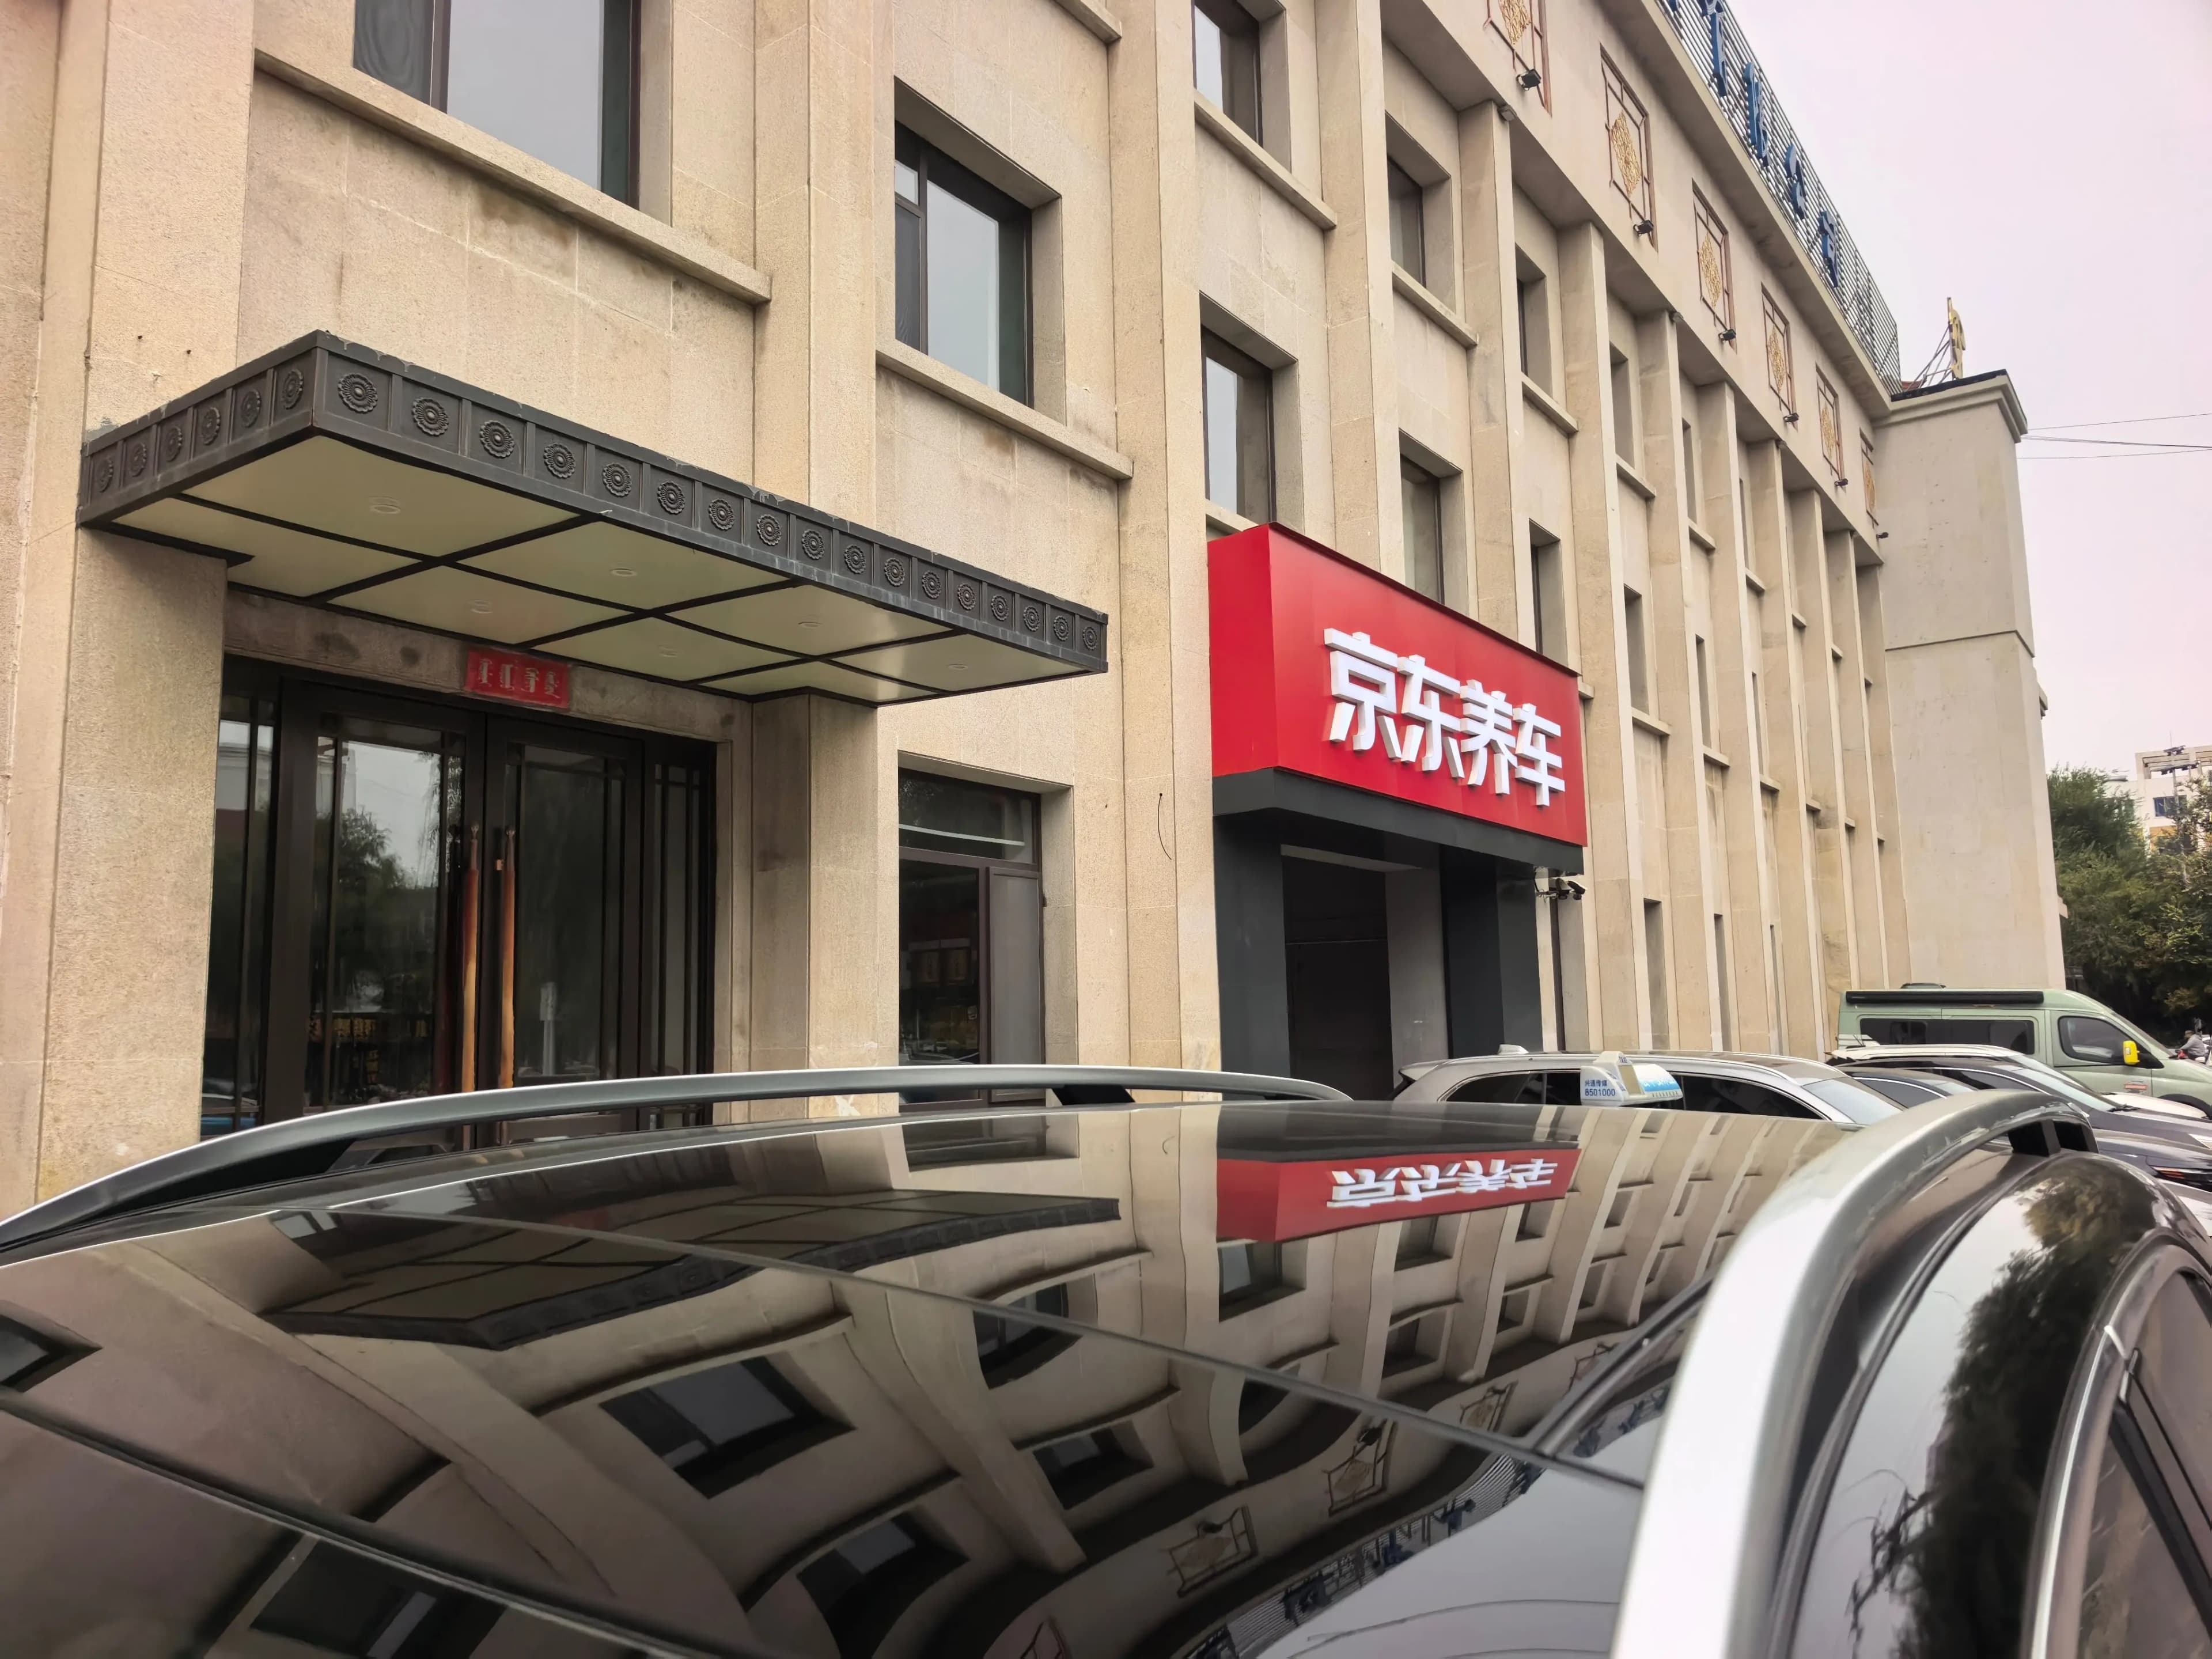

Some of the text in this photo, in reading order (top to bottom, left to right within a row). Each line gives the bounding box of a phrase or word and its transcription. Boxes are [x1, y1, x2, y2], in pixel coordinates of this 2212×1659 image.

[1324, 627, 1566, 808] 京东养车
[1585, 1088, 1616, 1096] 8501000
